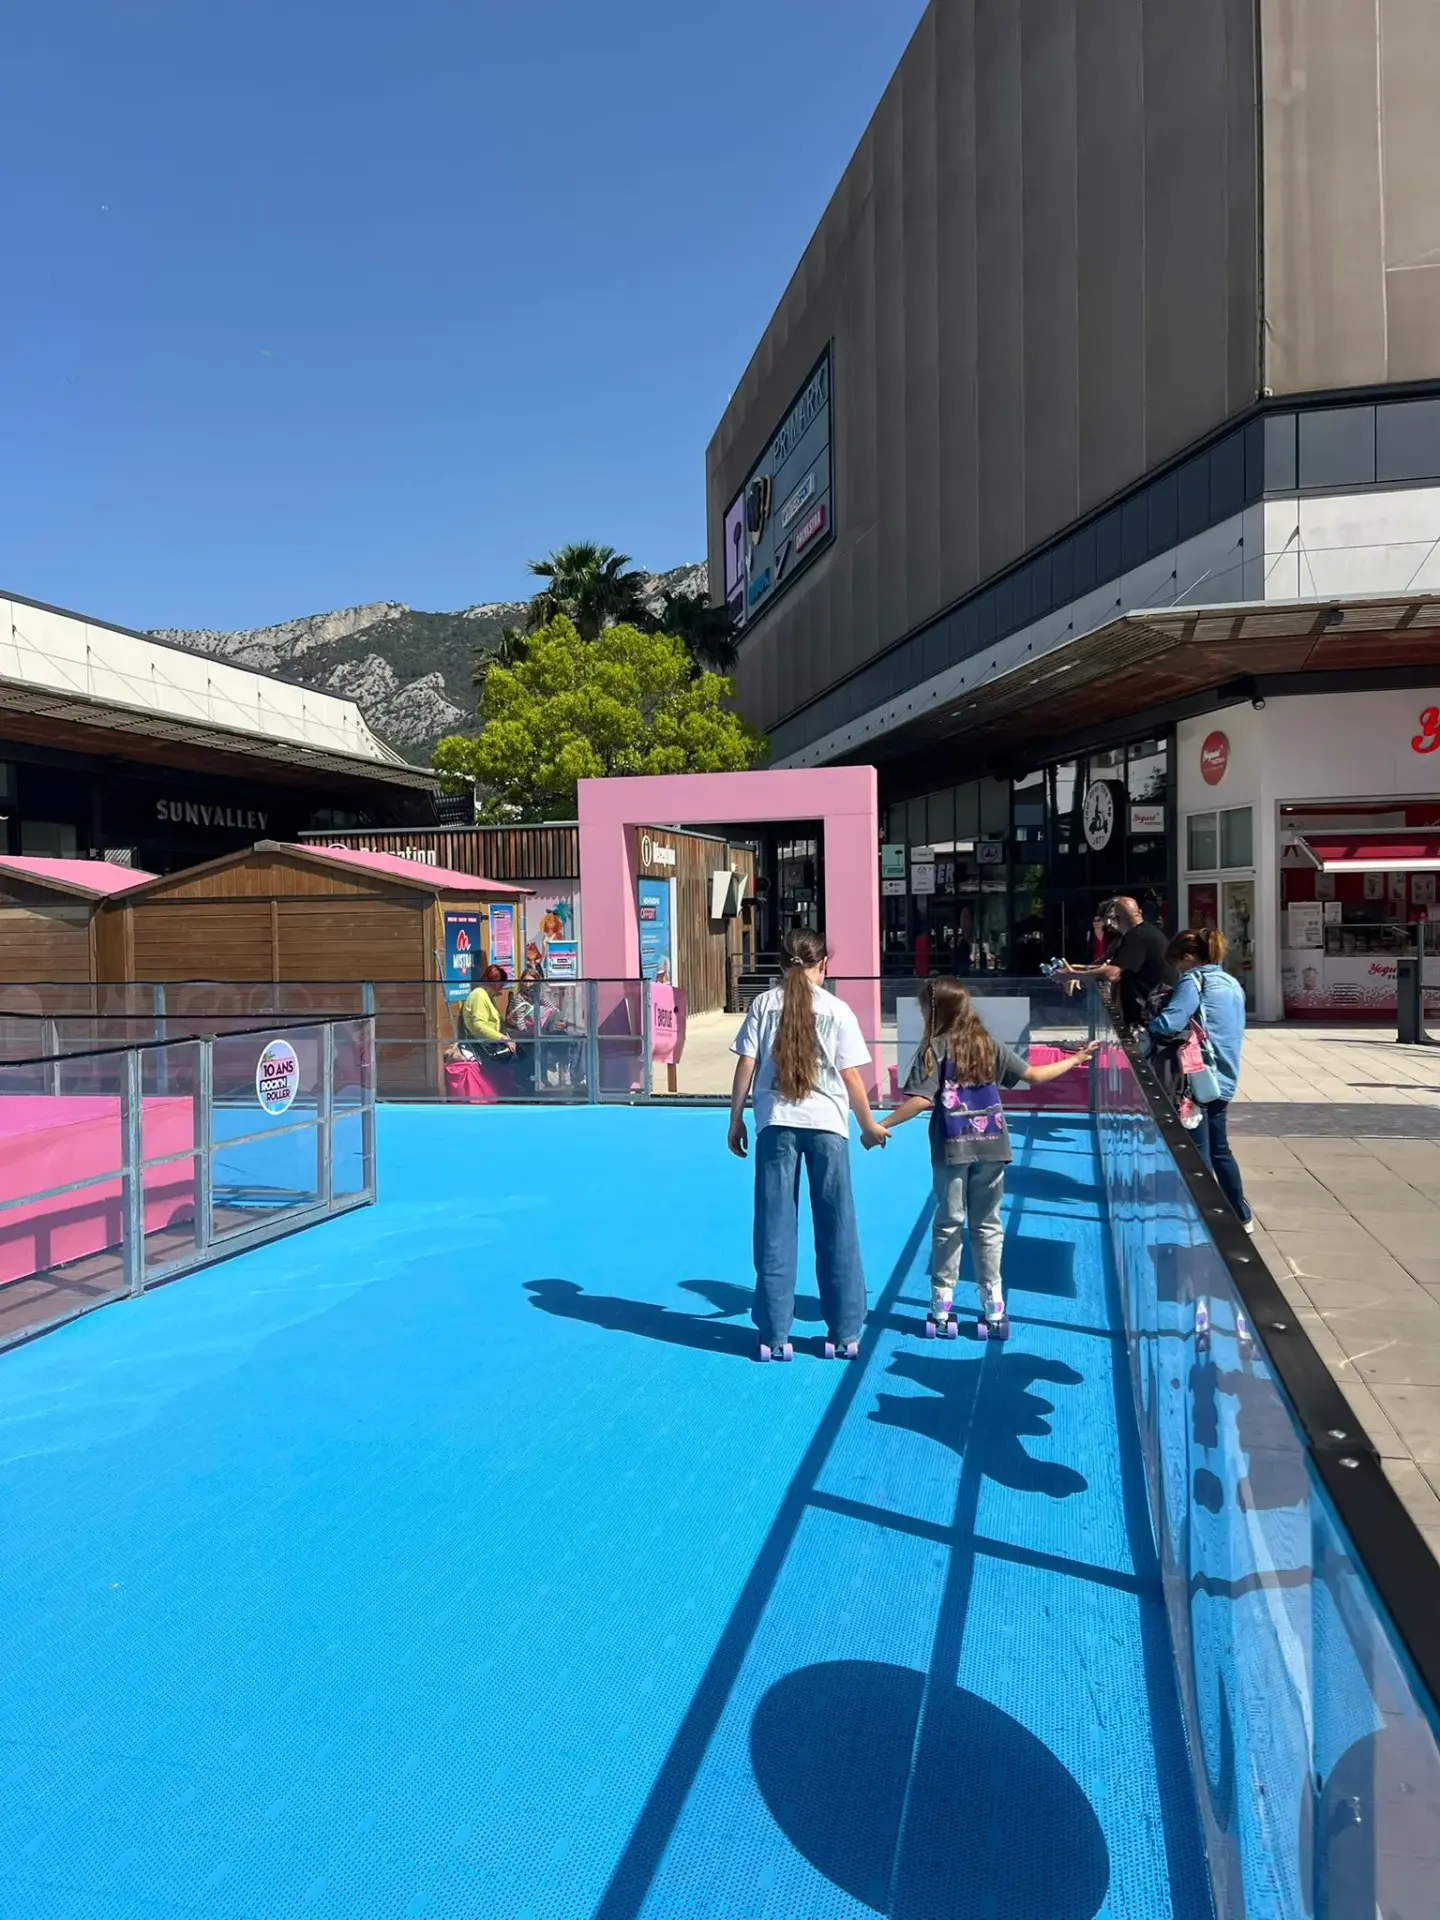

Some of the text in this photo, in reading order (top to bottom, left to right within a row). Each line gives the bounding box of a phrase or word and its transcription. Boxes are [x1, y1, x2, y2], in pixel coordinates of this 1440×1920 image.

[774, 368, 825, 460] PRIMARK
[155, 798, 268, 830] SUNVALLEY
[1367, 963, 1397, 977] Yogu
[263, 1060, 293, 1078] 10 ANS
[261, 1077, 286, 1091] ROCK'N
[266, 1088, 290, 1101] ROLLER
